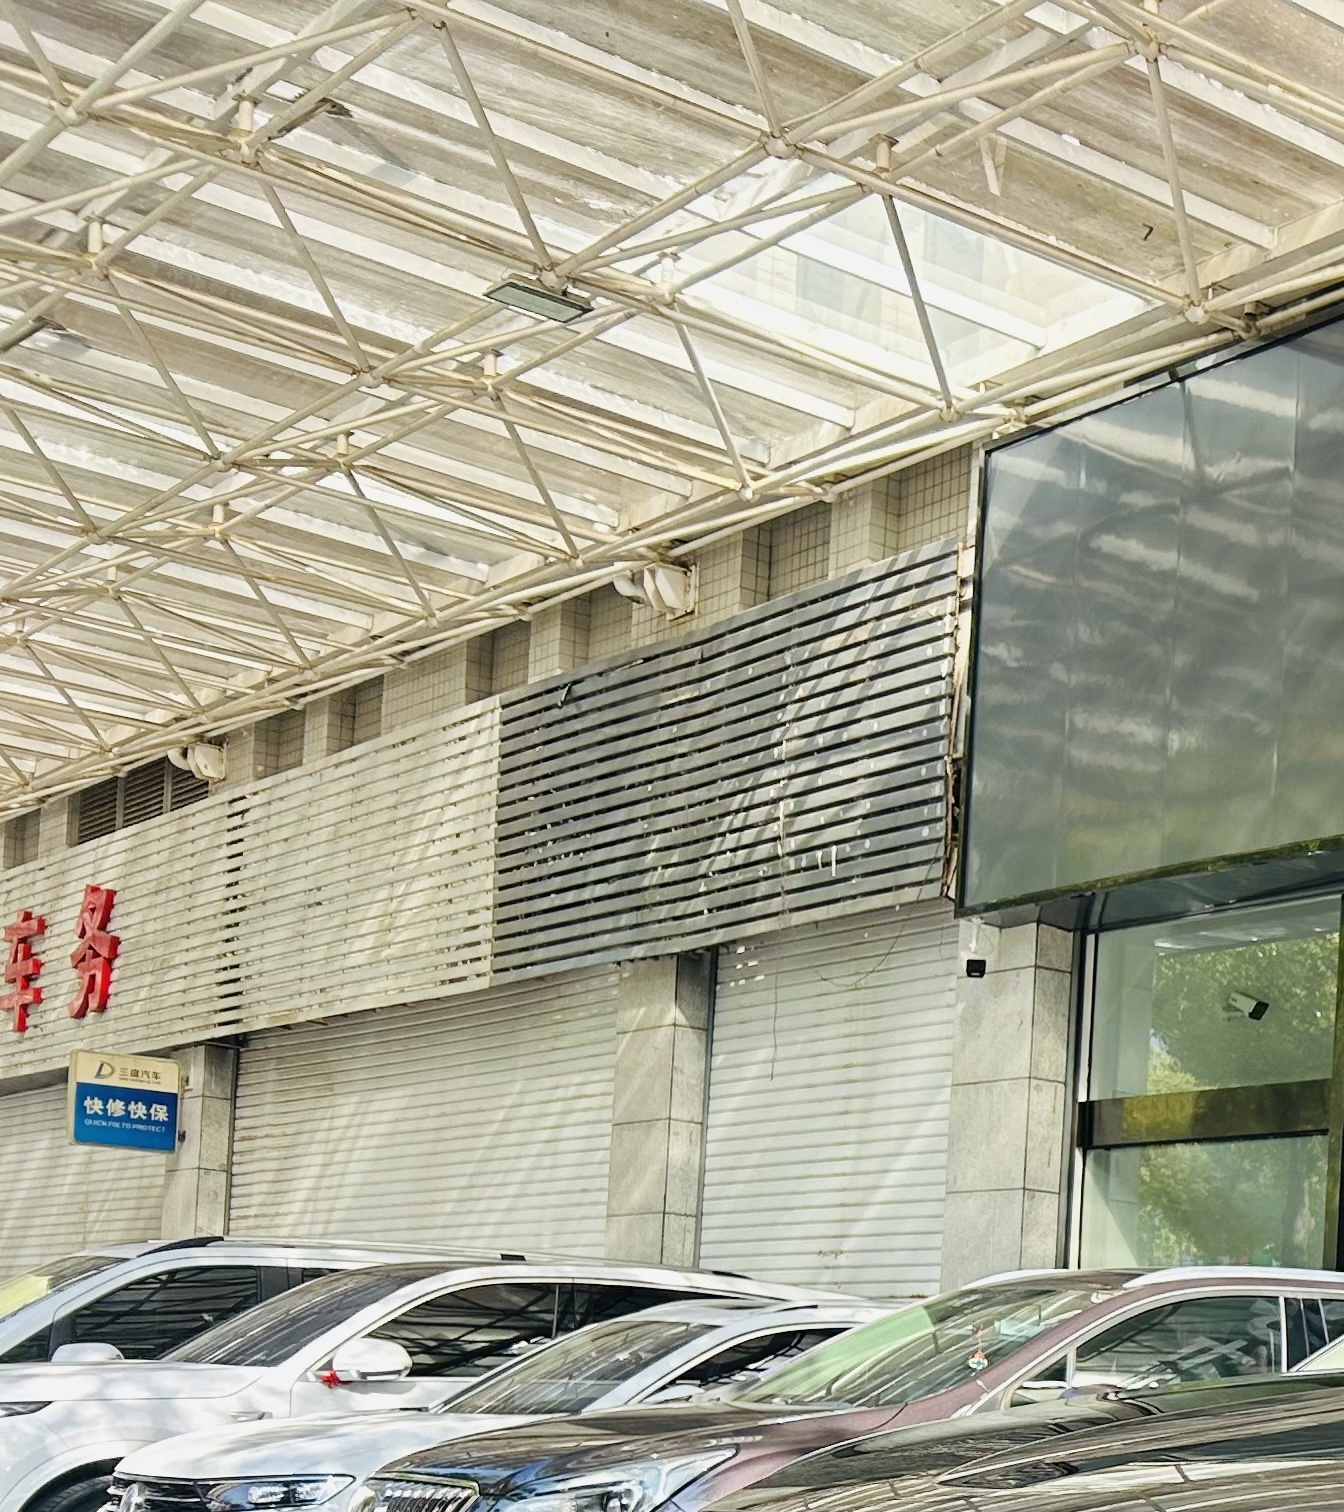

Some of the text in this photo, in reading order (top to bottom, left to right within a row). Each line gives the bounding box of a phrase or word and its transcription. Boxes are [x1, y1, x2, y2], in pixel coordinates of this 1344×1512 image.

[0, 884, 121, 1032] 车务
[83, 1096, 169, 1121] 快修快保
